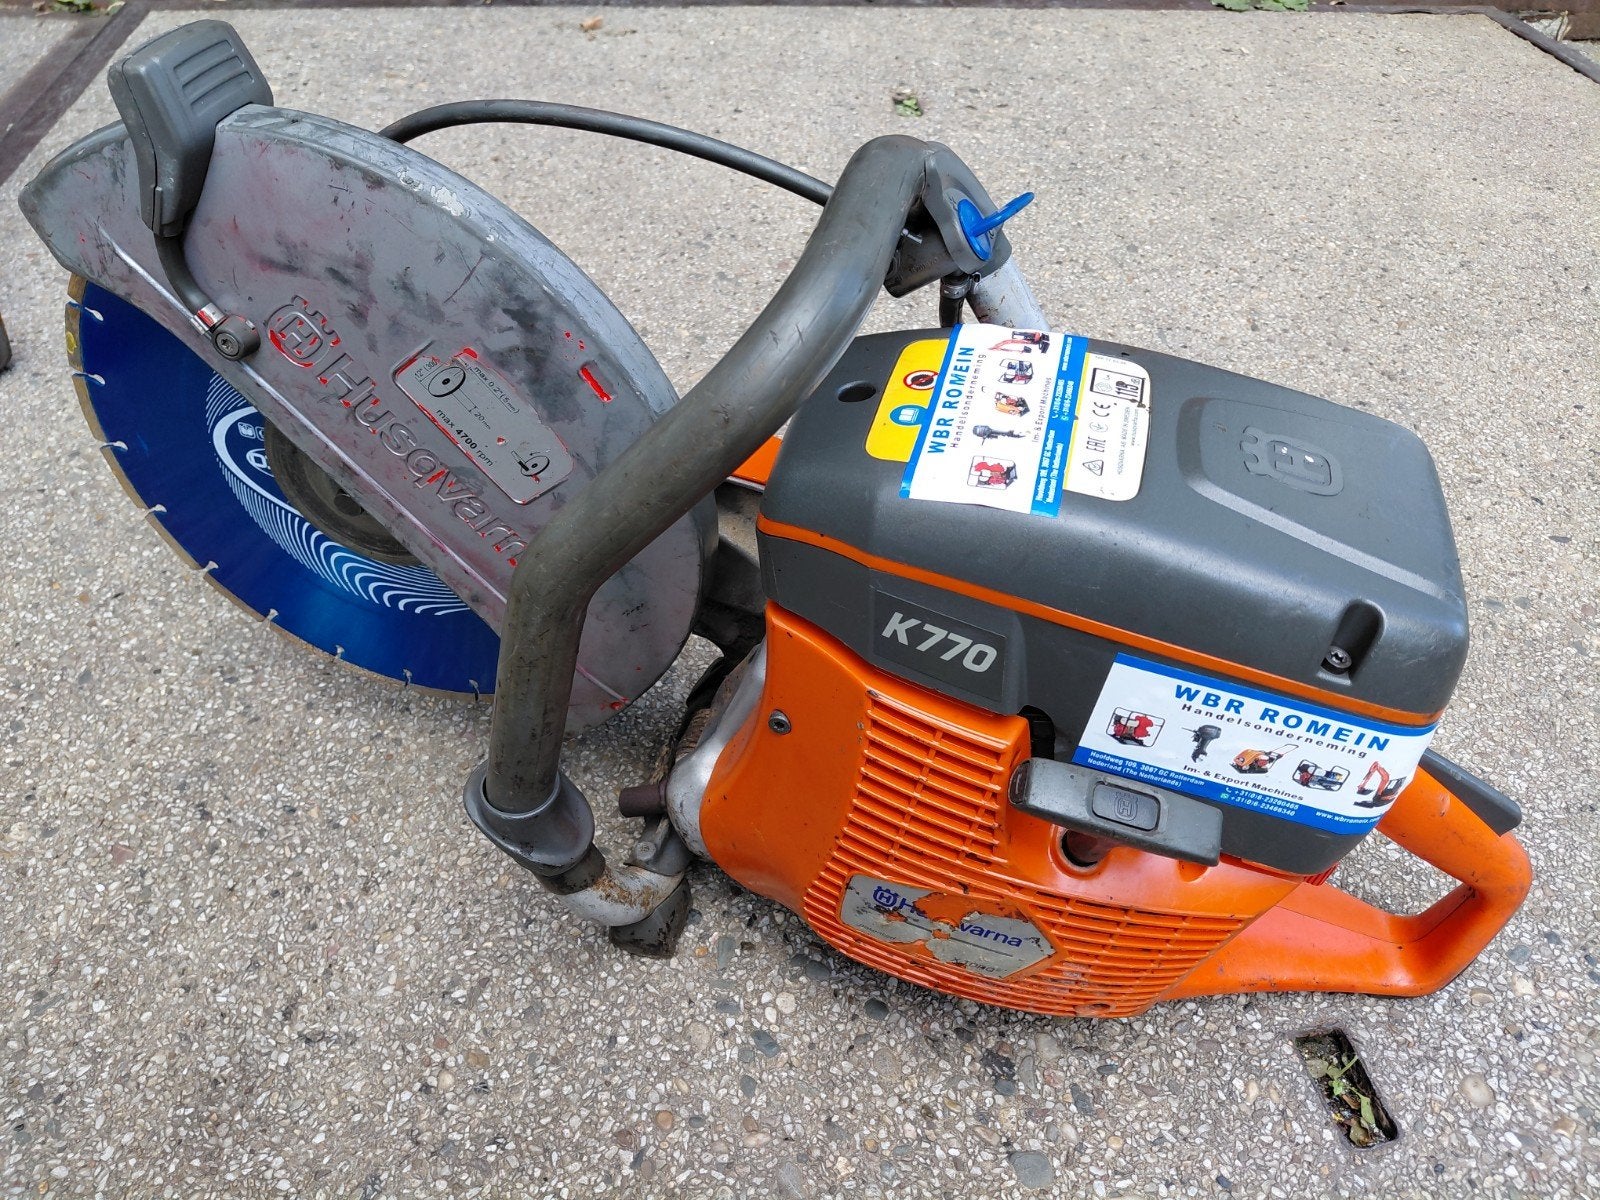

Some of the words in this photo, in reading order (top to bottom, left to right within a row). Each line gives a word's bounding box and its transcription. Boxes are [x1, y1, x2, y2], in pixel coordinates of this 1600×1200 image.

[474, 366, 489, 381] max
[927, 417, 954, 453] WBR
[942, 347, 975, 409] ROMEIN
[949, 354, 987, 448] Handelsonderneming
[316, 352, 529, 568] Husqvarn
[436, 409, 455, 429] max
[455, 428, 478, 449] 4700
[476, 449, 494, 467] rpm
[1174, 684, 1245, 715] WBR
[1259, 707, 1390, 751] ROMEIN
[1181, 703, 1367, 759] Handelsonderneming
[1214, 773, 1249, 787] Export
[1251, 782, 1304, 801] Machines
[899, 897, 1023, 948] Hvarna
